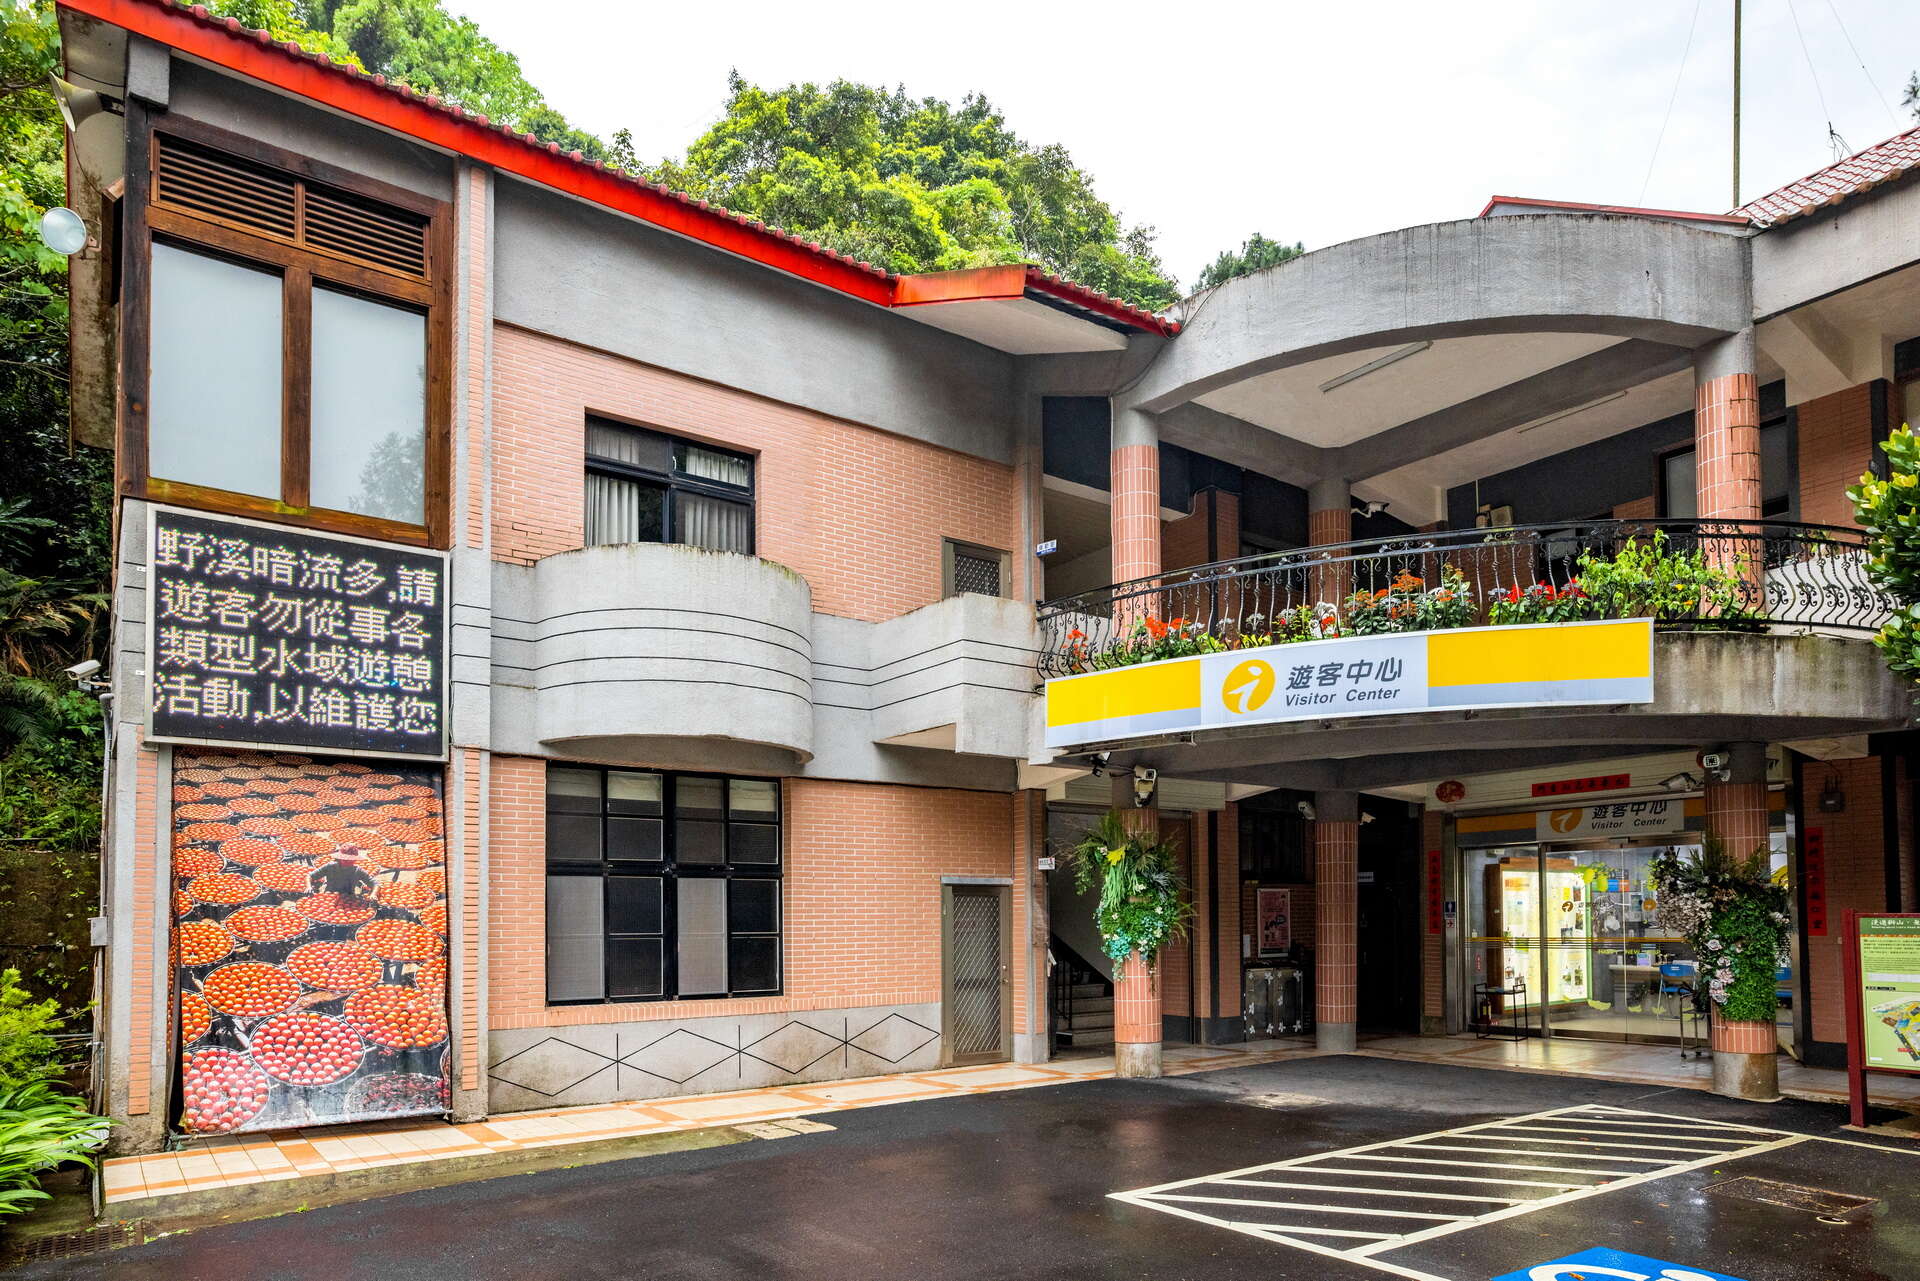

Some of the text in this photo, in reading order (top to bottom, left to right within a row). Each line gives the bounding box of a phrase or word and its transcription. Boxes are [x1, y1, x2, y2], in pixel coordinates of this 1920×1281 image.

[160, 577, 432, 649] 遊客勿從事各
[160, 626, 432, 691] 類型水域遊憩
[1286, 657, 1402, 690] 遊客中心
[1286, 688, 1400, 706] Visitor Center
[1592, 801, 1667, 819] 遊客中心
[1592, 818, 1666, 829] Visitor Center
